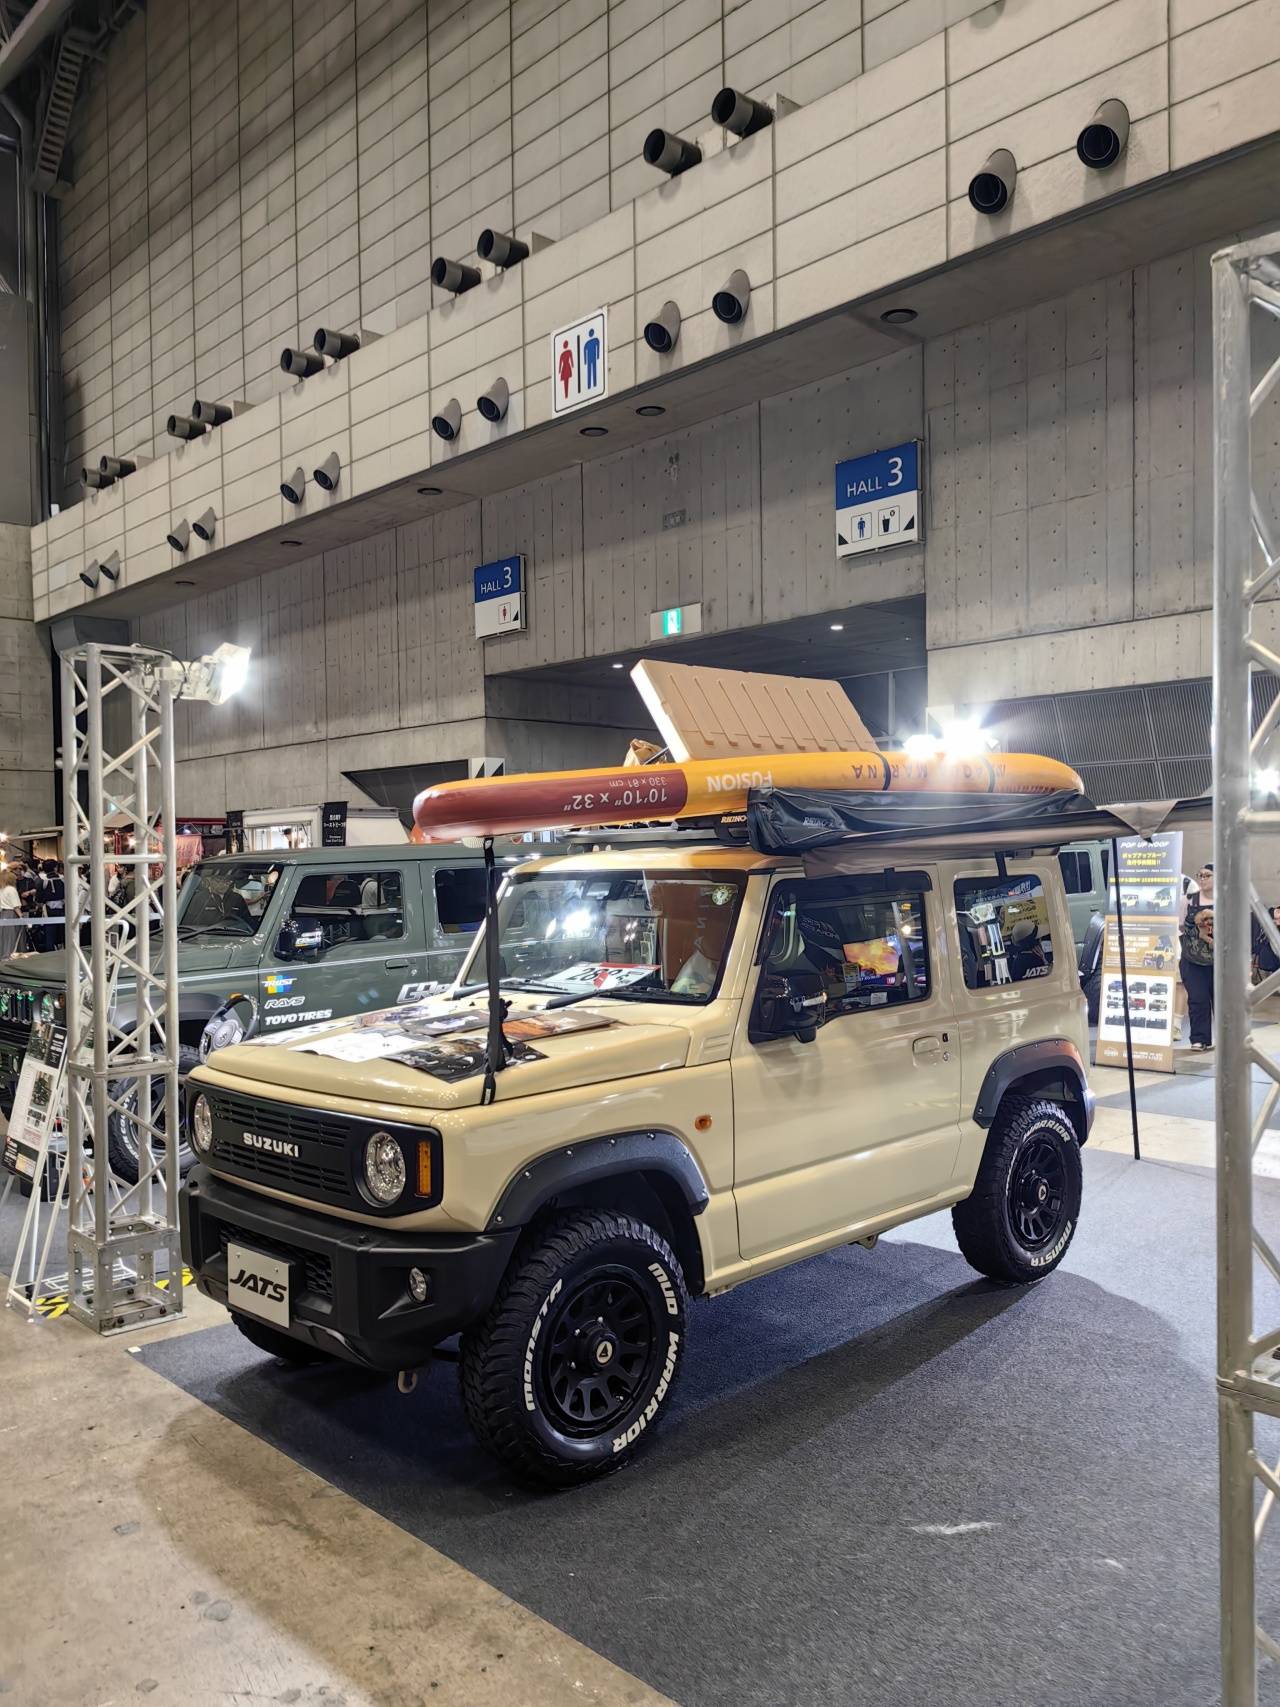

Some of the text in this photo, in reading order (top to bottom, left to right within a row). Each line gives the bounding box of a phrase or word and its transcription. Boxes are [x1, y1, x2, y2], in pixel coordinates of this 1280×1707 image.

[847, 457, 903, 498] HALL 3
[480, 566, 512, 595] HALL 3
[609, 779, 624, 787] cm
[627, 778, 640, 788] 81
[649, 776, 668, 787] 330
[706, 770, 773, 793] FUSION
[851, 764, 928, 779] MARNA
[1022, 966, 1048, 978] JATS
[264, 996, 305, 1009] RAYS
[265, 1009, 333, 1026] TOYO TIRES
[243, 1132, 299, 1158] SUZUKI
[1030, 1220, 1072, 1266] MONSTA
[230, 1269, 288, 1303] JATS
[523, 1278, 563, 1411] MONSTA
[612, 1262, 679, 1453] MUD WARRIOR
